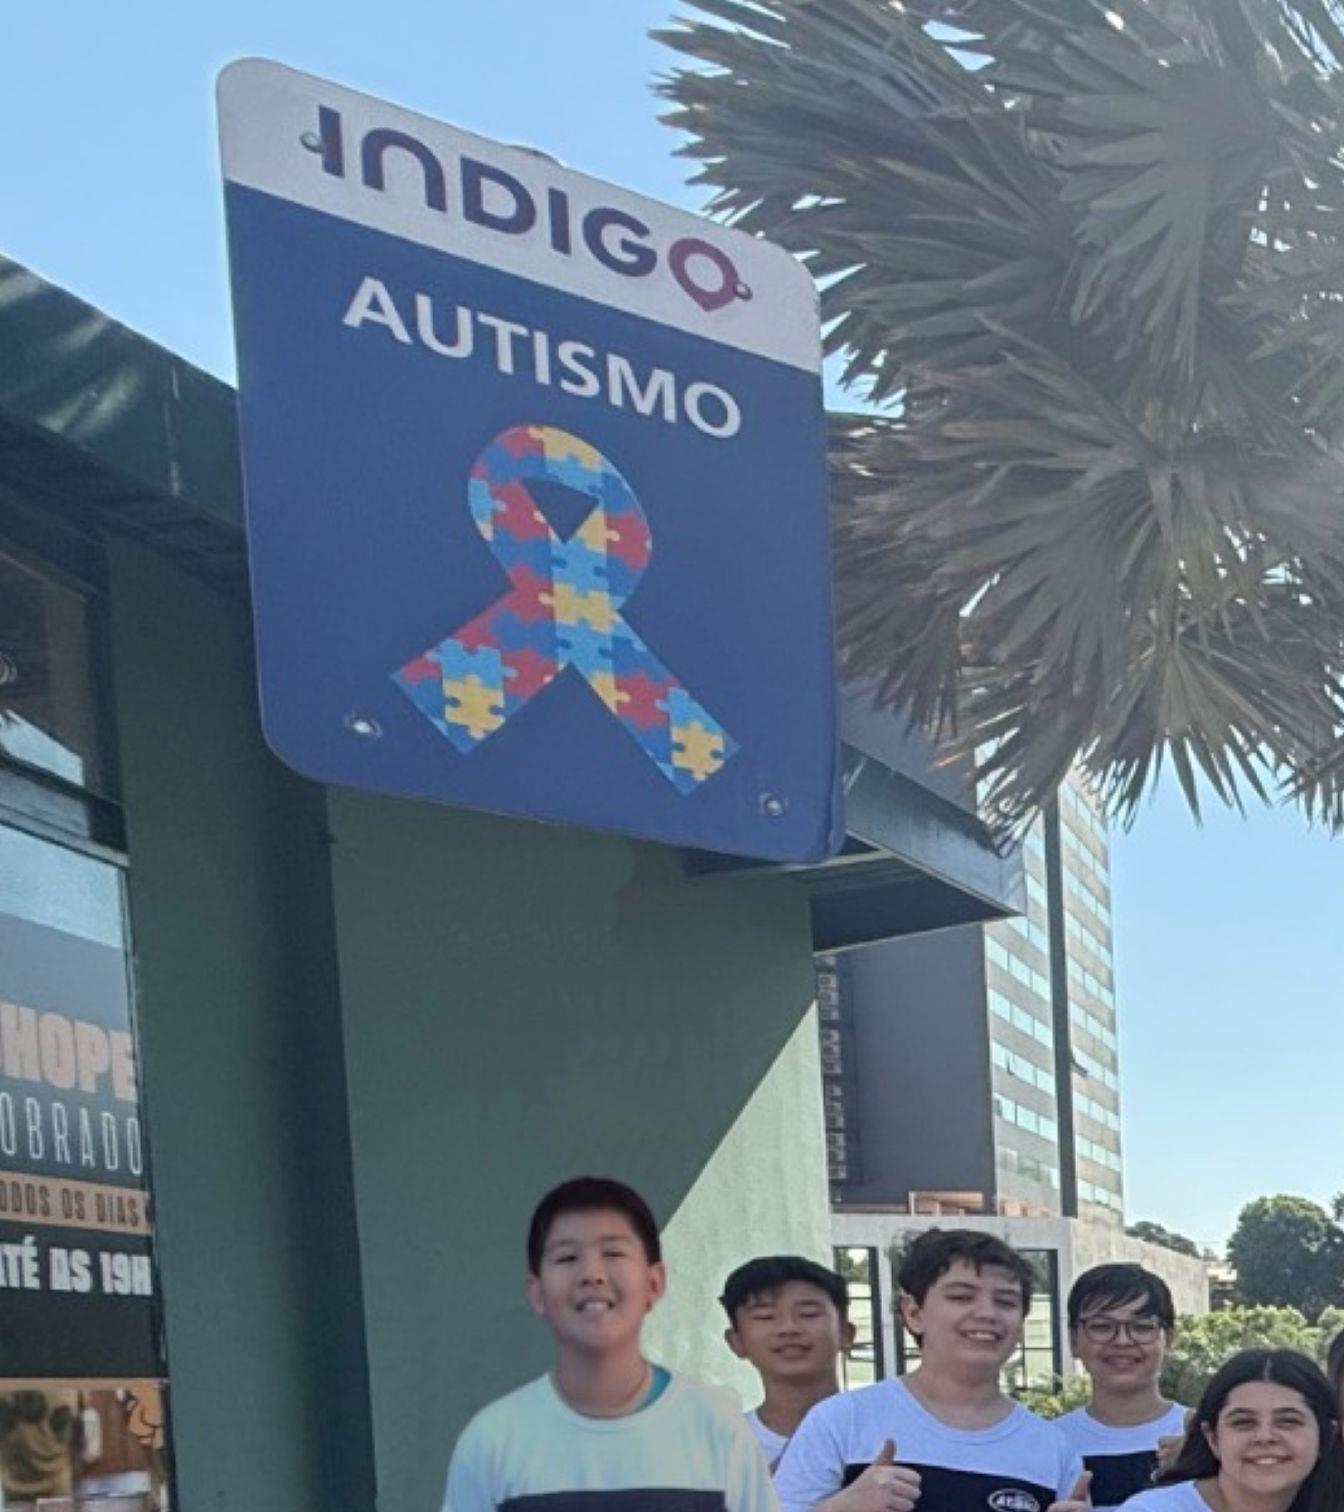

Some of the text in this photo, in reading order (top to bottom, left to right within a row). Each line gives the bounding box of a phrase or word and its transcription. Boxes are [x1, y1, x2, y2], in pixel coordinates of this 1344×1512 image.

[319, 103, 742, 312] INDIGO
[342, 276, 741, 438] AUTISMO
[99, 1251, 153, 1296] 19H
